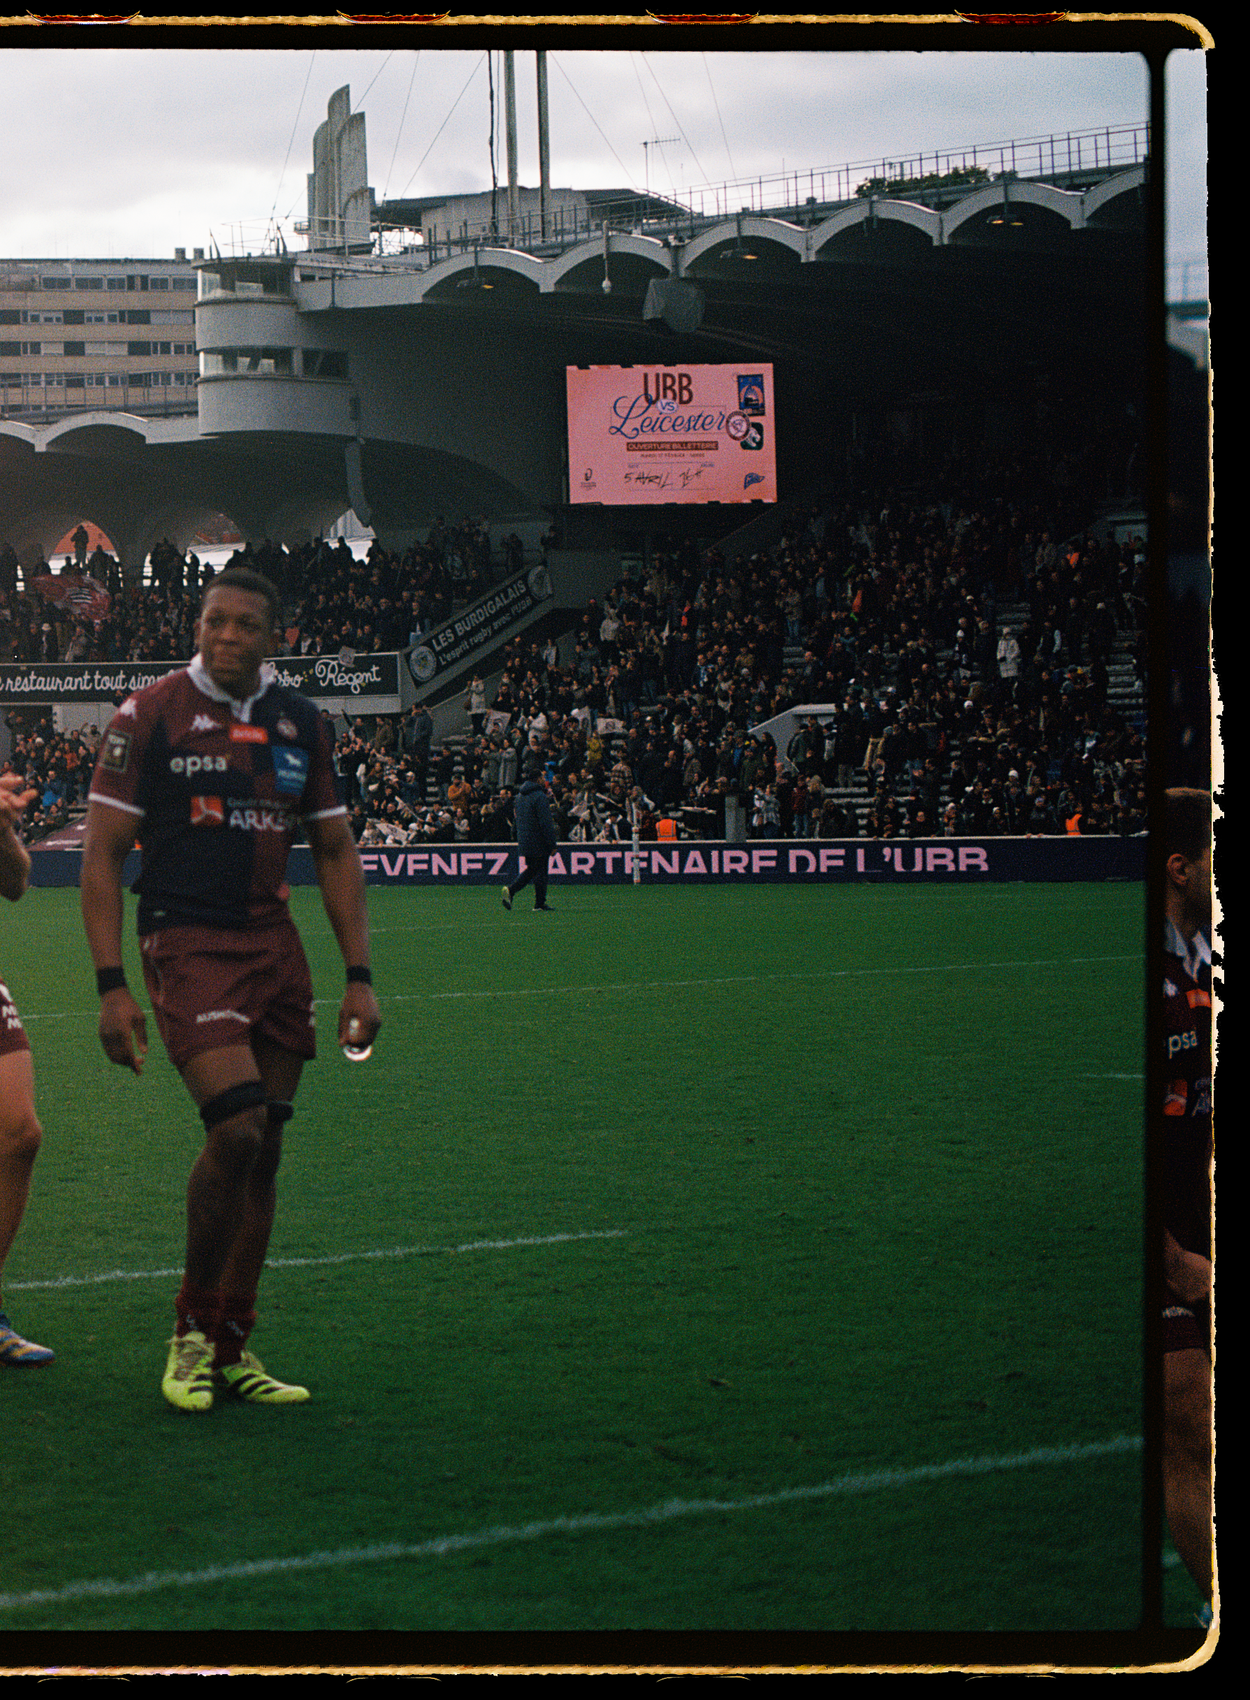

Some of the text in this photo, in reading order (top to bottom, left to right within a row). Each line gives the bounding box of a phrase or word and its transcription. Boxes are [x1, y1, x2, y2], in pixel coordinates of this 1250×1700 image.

[643, 372, 694, 405] UBB
[608, 393, 726, 439] Leicester
[432, 580, 526, 651] LES BURDIGALAIS
[469, 626, 492, 645] rugby
[5, 669, 94, 692] restaurant
[94, 669, 127, 690] tout
[315, 659, 381, 694] Régent
[170, 754, 227, 777] epsa
[789, 848, 845, 873] DE
[856, 846, 989, 872] L'UBB
